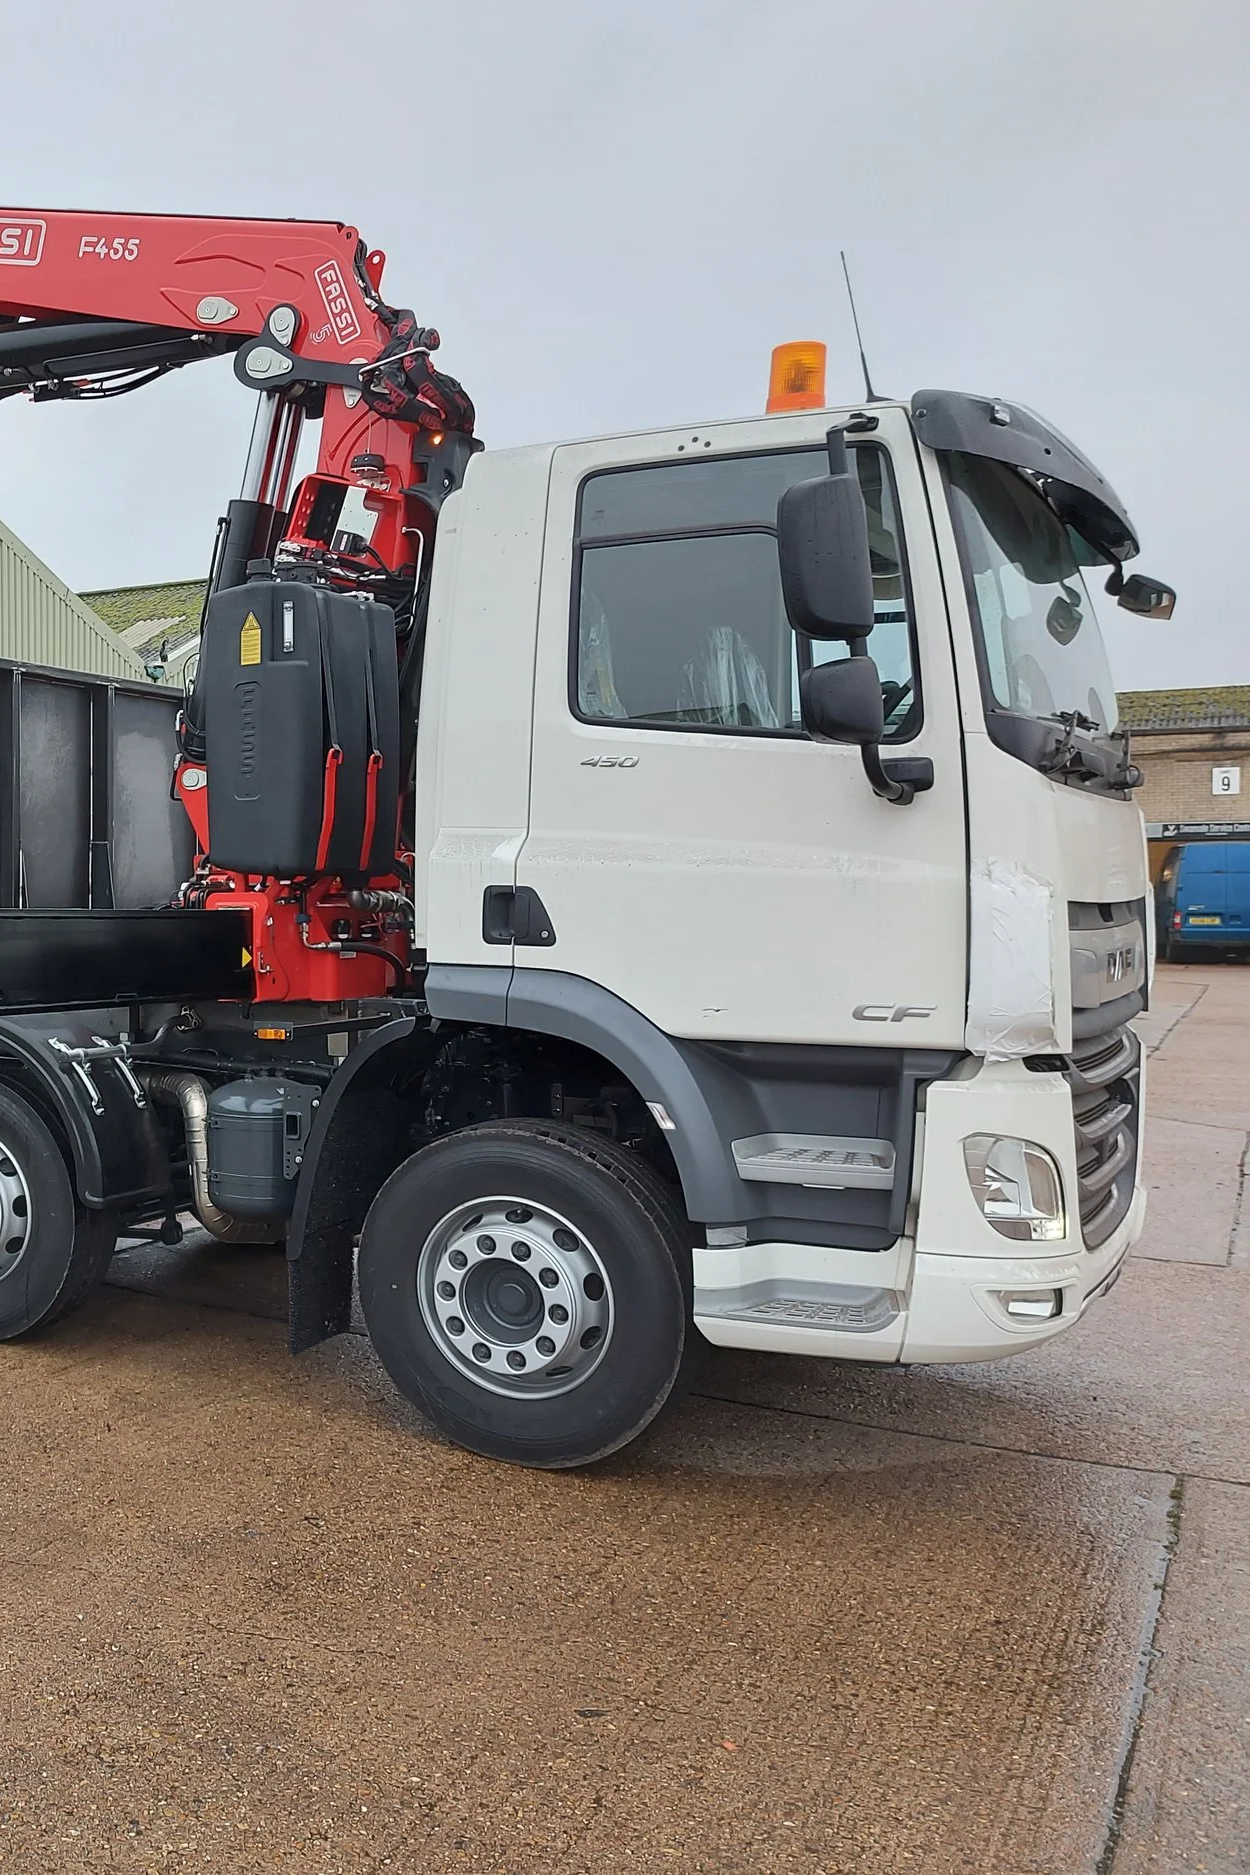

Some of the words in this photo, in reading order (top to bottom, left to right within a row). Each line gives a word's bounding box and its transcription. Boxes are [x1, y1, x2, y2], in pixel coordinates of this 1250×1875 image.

[78, 236, 141, 261] F455
[320, 269, 355, 336] FASSI
[580, 755, 640, 768] 450
[1221, 776, 1231, 792] 9
[852, 1003, 938, 1022] CF
